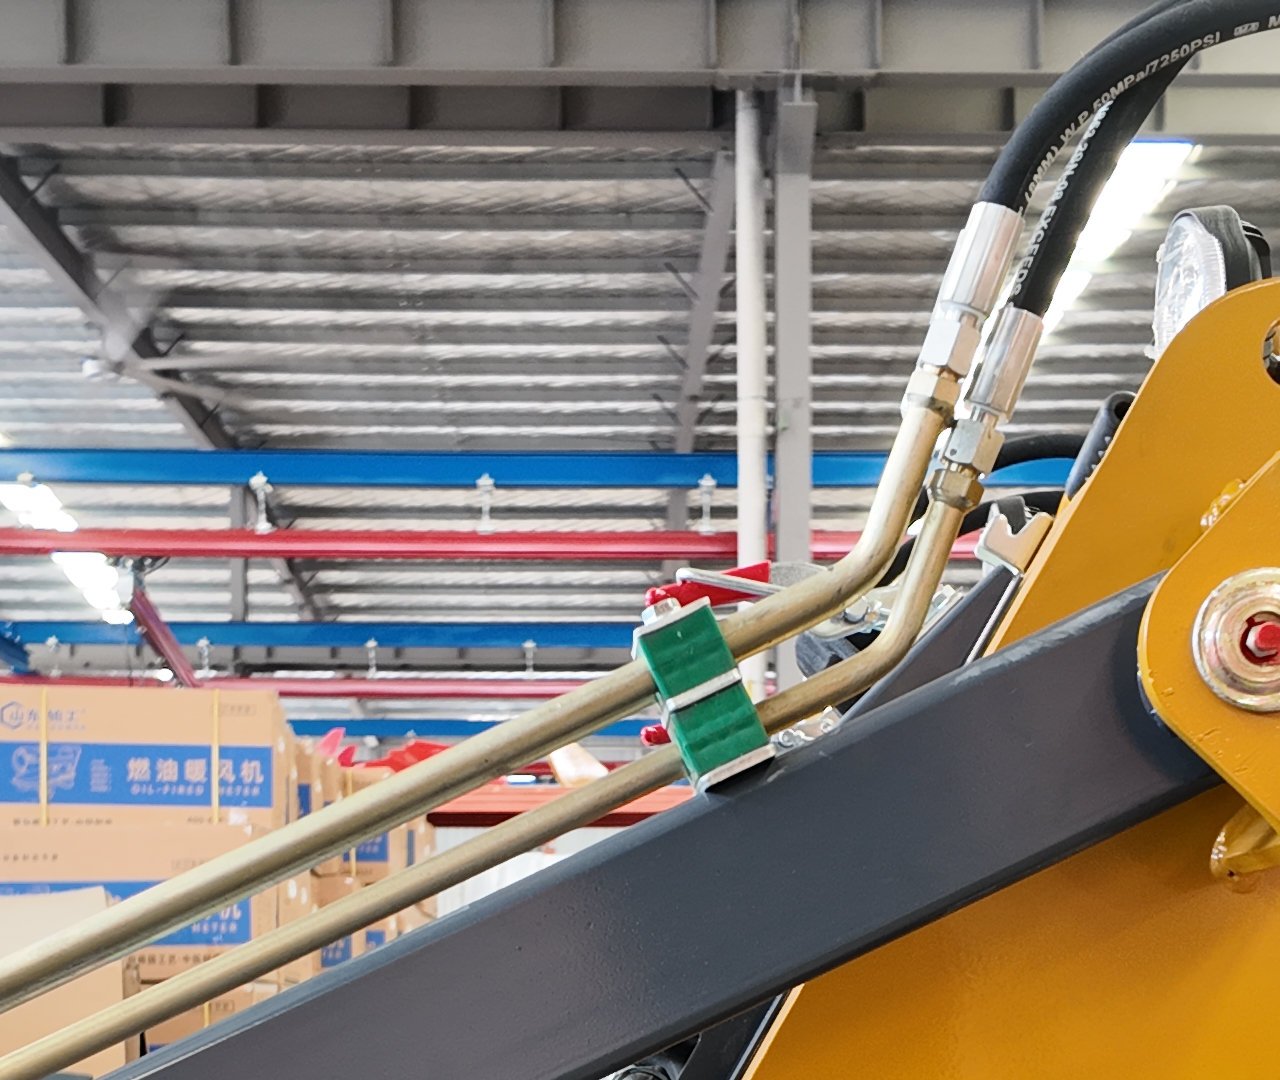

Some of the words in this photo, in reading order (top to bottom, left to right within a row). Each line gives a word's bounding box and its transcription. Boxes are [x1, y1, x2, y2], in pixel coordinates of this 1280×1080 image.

[126, 757, 265, 784] 燃油暖风机
